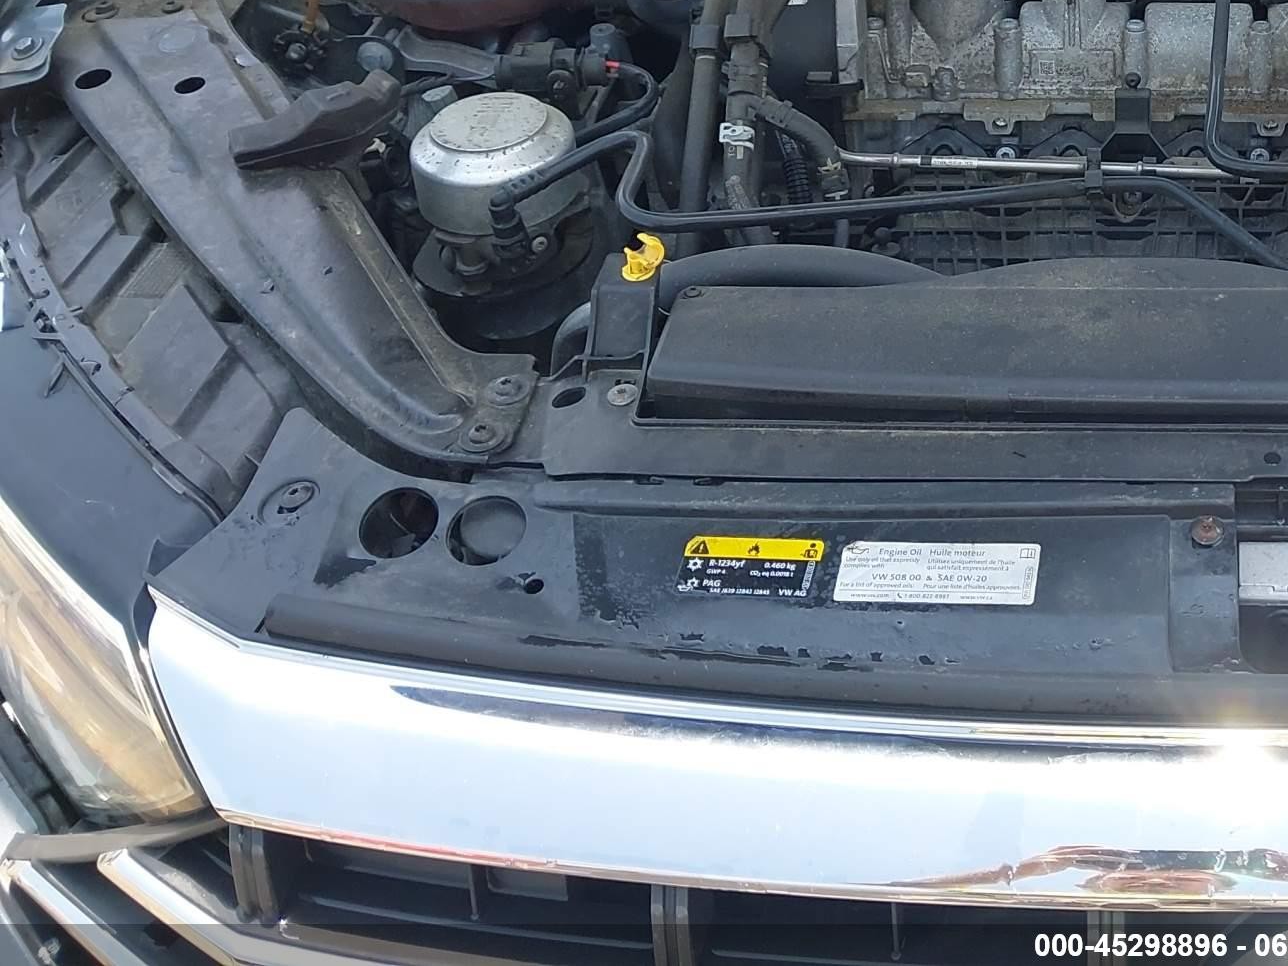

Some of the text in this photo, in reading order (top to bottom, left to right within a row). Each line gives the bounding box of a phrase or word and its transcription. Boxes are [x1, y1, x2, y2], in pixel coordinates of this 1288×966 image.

[879, 548, 922, 557] Engine Oil
[929, 548, 952, 556] Huile
[708, 560, 746, 569] R-1234yf
[786, 562, 797, 571] kg
[937, 574, 955, 582] SAE
[702, 579, 722, 587] PAG
